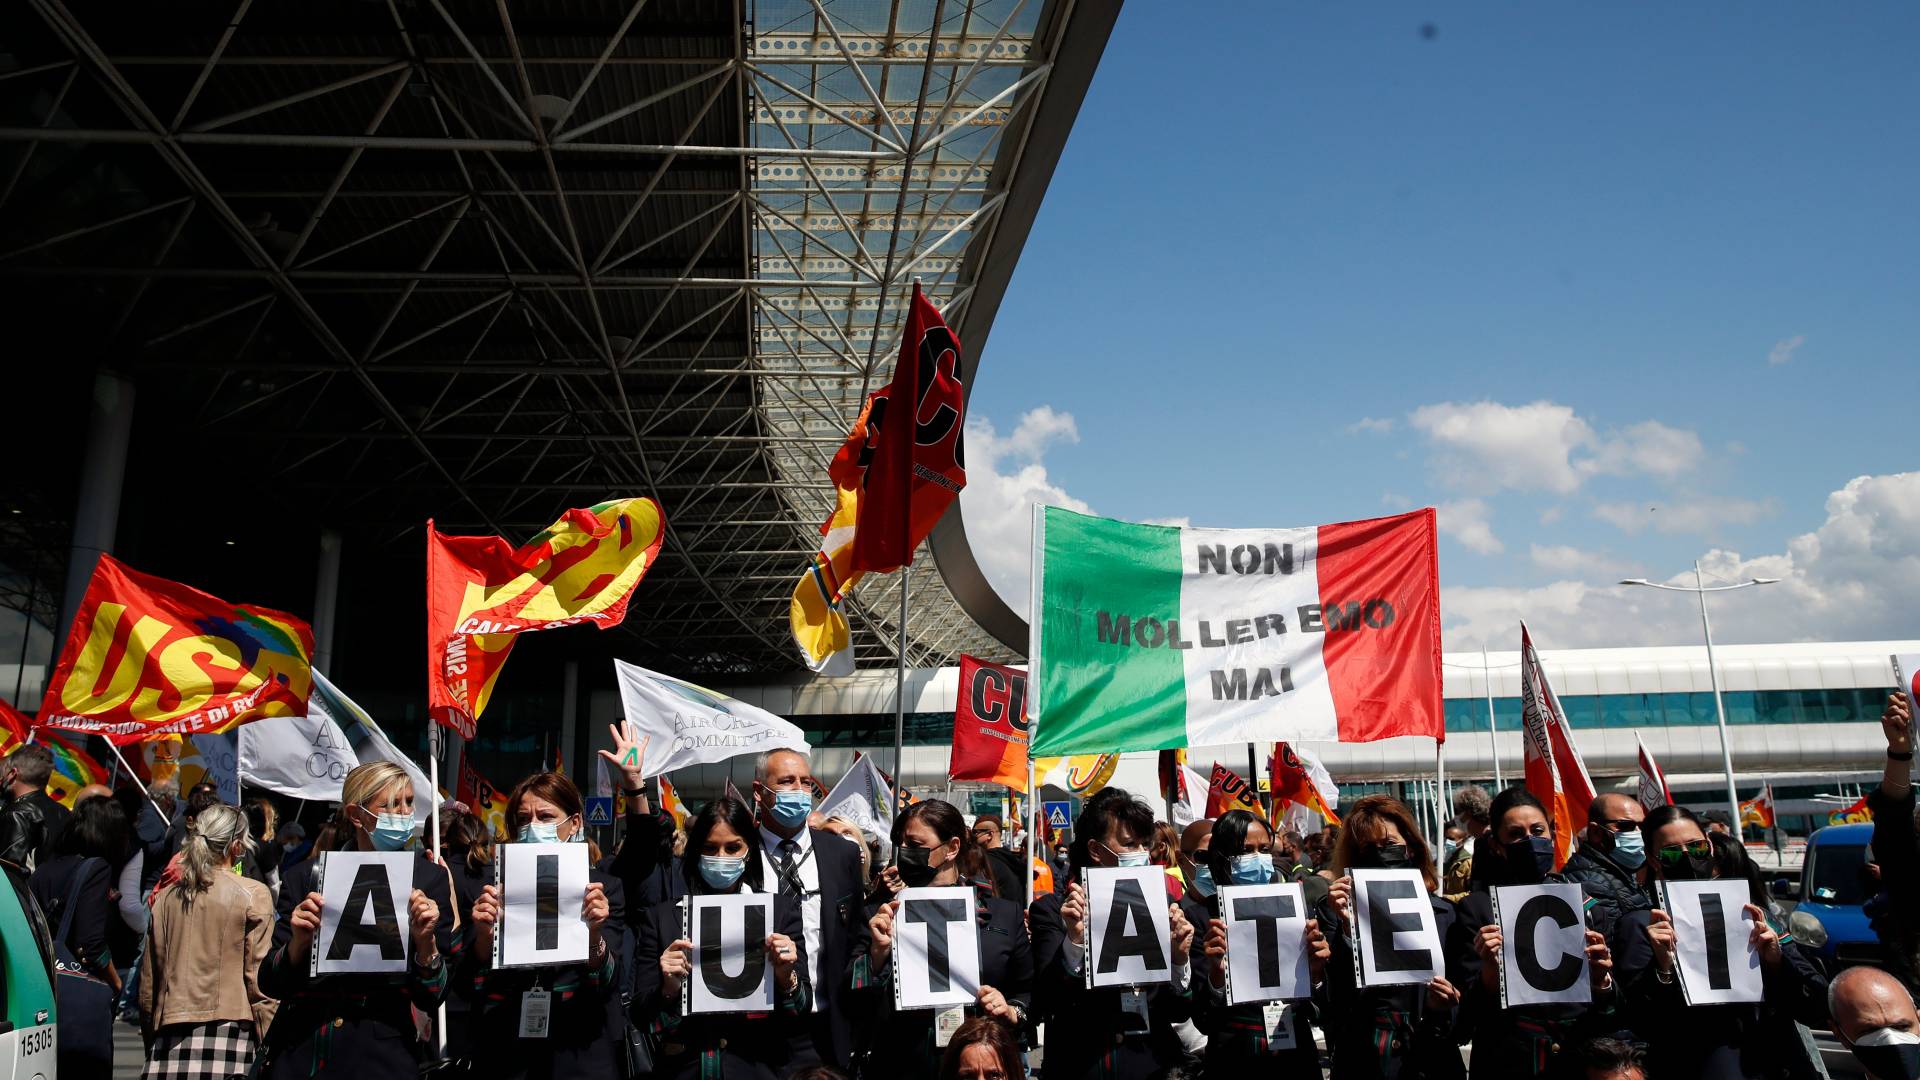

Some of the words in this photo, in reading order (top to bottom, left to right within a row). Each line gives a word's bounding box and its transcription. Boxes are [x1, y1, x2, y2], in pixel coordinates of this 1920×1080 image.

[1198, 543, 1294, 575] NON
[971, 667, 1029, 732] CU
[1210, 667, 1296, 701] MAI
[1211, 766, 1258, 807] CUB
[326, 864, 405, 960] A
[536, 855, 558, 950] I
[905, 899, 966, 992] T
[1097, 879, 1167, 973] A
[1233, 896, 1296, 988] T
[1366, 880, 1434, 973] E
[1514, 895, 1584, 992] C
[1699, 893, 1731, 990] I
[700, 905, 766, 999] U
[22, 1028, 52, 1057] 15305
